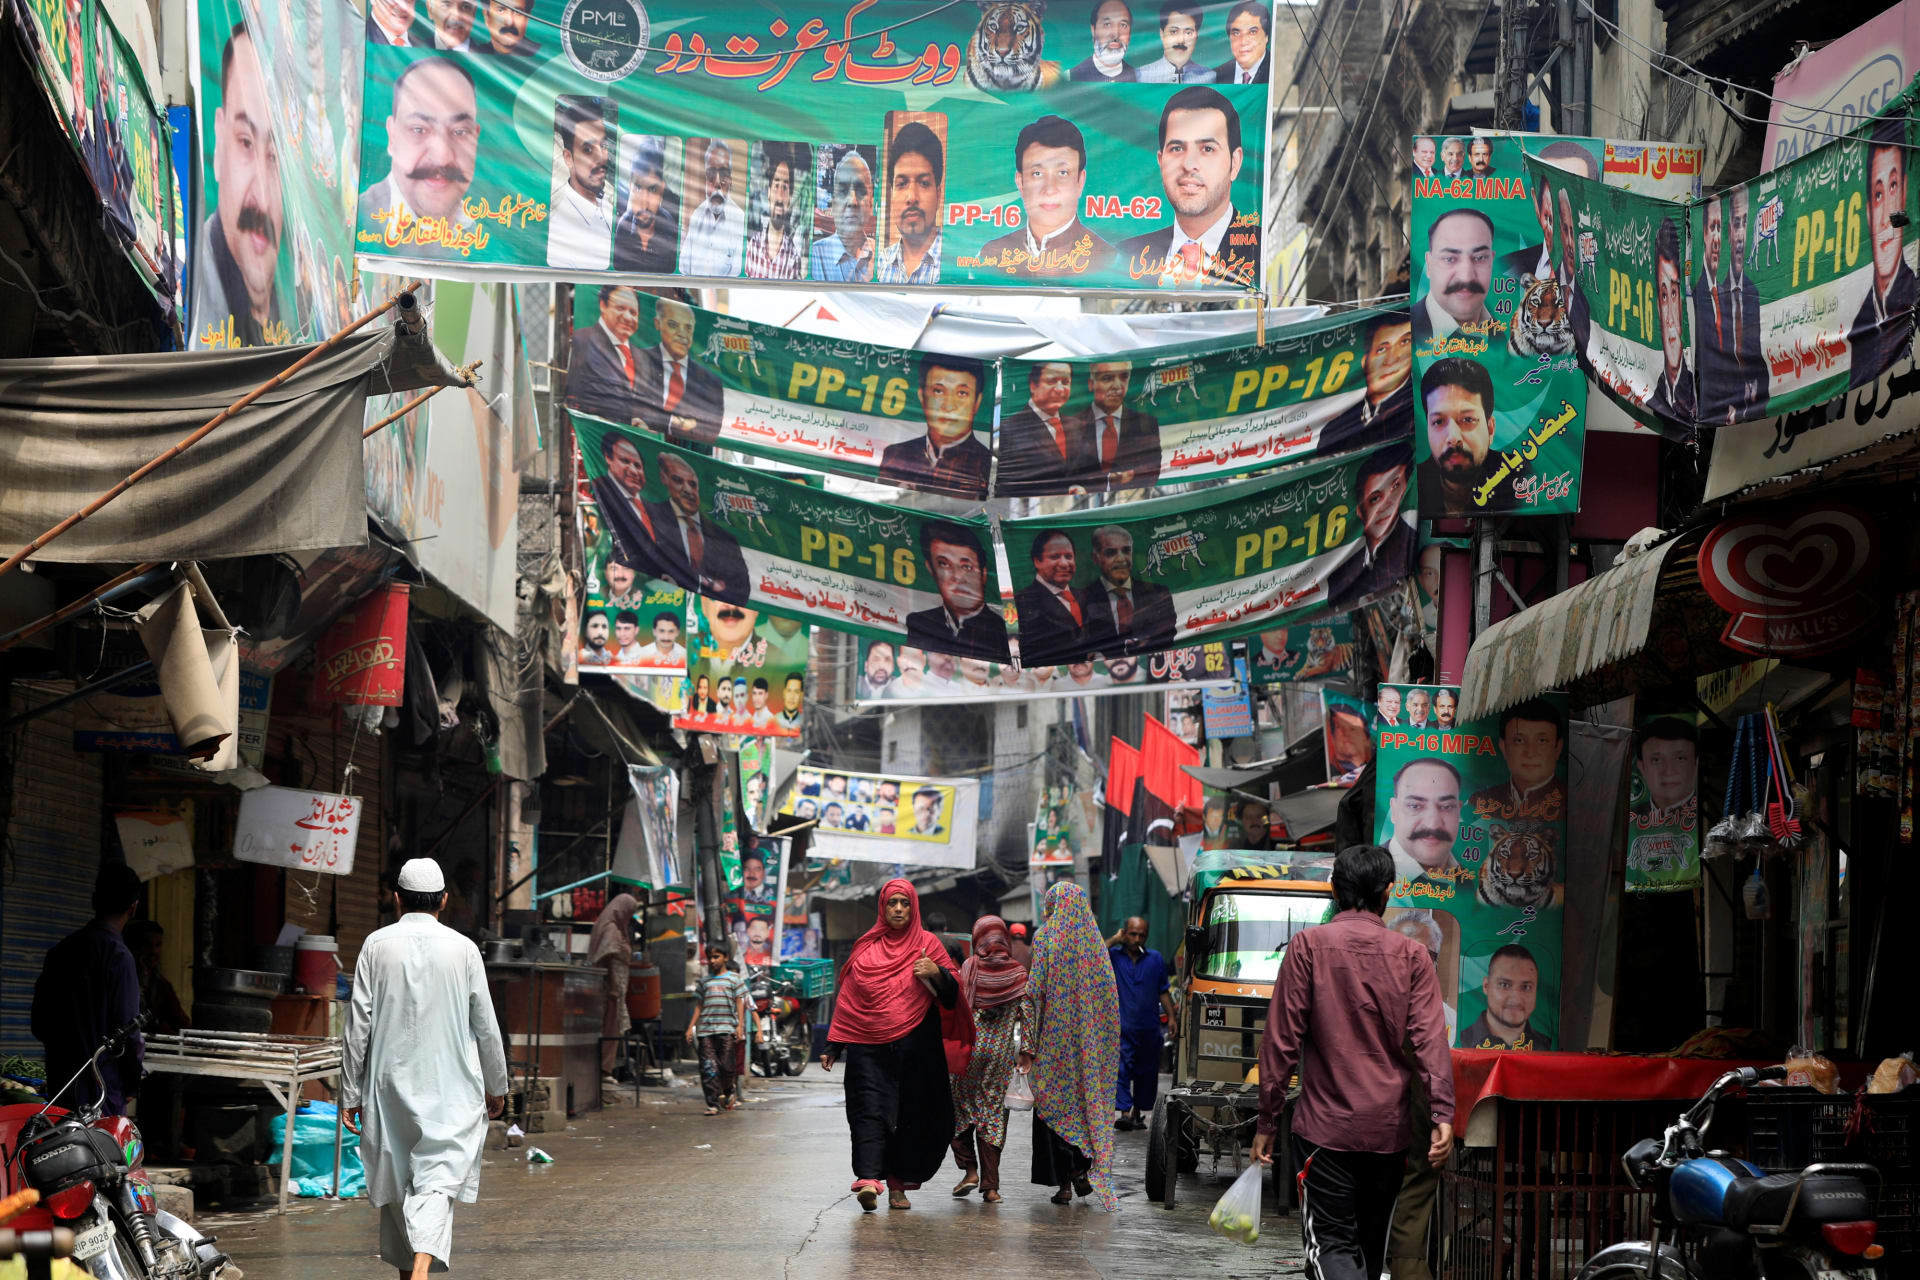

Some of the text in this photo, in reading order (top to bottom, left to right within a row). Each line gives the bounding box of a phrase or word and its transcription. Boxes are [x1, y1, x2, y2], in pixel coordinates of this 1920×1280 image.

[581, 10, 627, 27] PML
[655, 33, 707, 73] دو
[703, 18, 830, 92] عزت
[1774, 78, 1896, 167] PARADISE
[1651, 144, 1703, 179] اتفاق
[1414, 177, 1527, 200] NA-62 MNA
[949, 204, 1021, 227] PP-16
[1086, 196, 1162, 218] NA-62
[1761, 203, 1777, 232] VOTE
[1229, 232, 1258, 246] MNA
[1792, 191, 1862, 288] PP-16
[957, 256, 981, 267] MPA
[1493, 278, 1516, 294] UC
[1494, 299, 1513, 314] 40
[1608, 268, 1653, 343] PP-16
[723, 335, 751, 352] VOTE
[1160, 366, 1189, 385] VOTE
[1226, 351, 1355, 413] PP-16
[1513, 353, 1551, 386] شیر
[788, 362, 909, 416] PP-16
[731, 415, 875, 459] شیخ ارسلان حفیظ
[1170, 424, 1314, 470] شیخ ارسلان حفیظ
[1472, 398, 1578, 507] فیضان یاسین
[714, 475, 750, 492] شیر
[727, 494, 755, 511] VOTE
[1150, 514, 1187, 540] شیر
[1162, 535, 1190, 554] VOTE
[1234, 504, 1350, 577] PP-16
[800, 525, 917, 585] PP-16
[759, 575, 899, 625] شیخ ارسلان حفیظ
[1283, 578, 1321, 608] شیخ
[1228, 591, 1284, 623] ارسلان
[1184, 608, 1228, 632] حفیظ
[1768, 615, 1839, 641] WALL'S
[1204, 653, 1225, 672] 62
[1379, 731, 1497, 757] PP-16 MPA
[1461, 826, 1483, 841] UC
[1649, 840, 1673, 851] VOTE
[1461, 847, 1481, 862] 40
[1496, 905, 1537, 936] شیر
[1203, 1041, 1241, 1057] CNG
[32, 1143, 78, 1165] HONDA
[1812, 1191, 1867, 1201] HONDA
[88, 1231, 110, 1248] 9028
